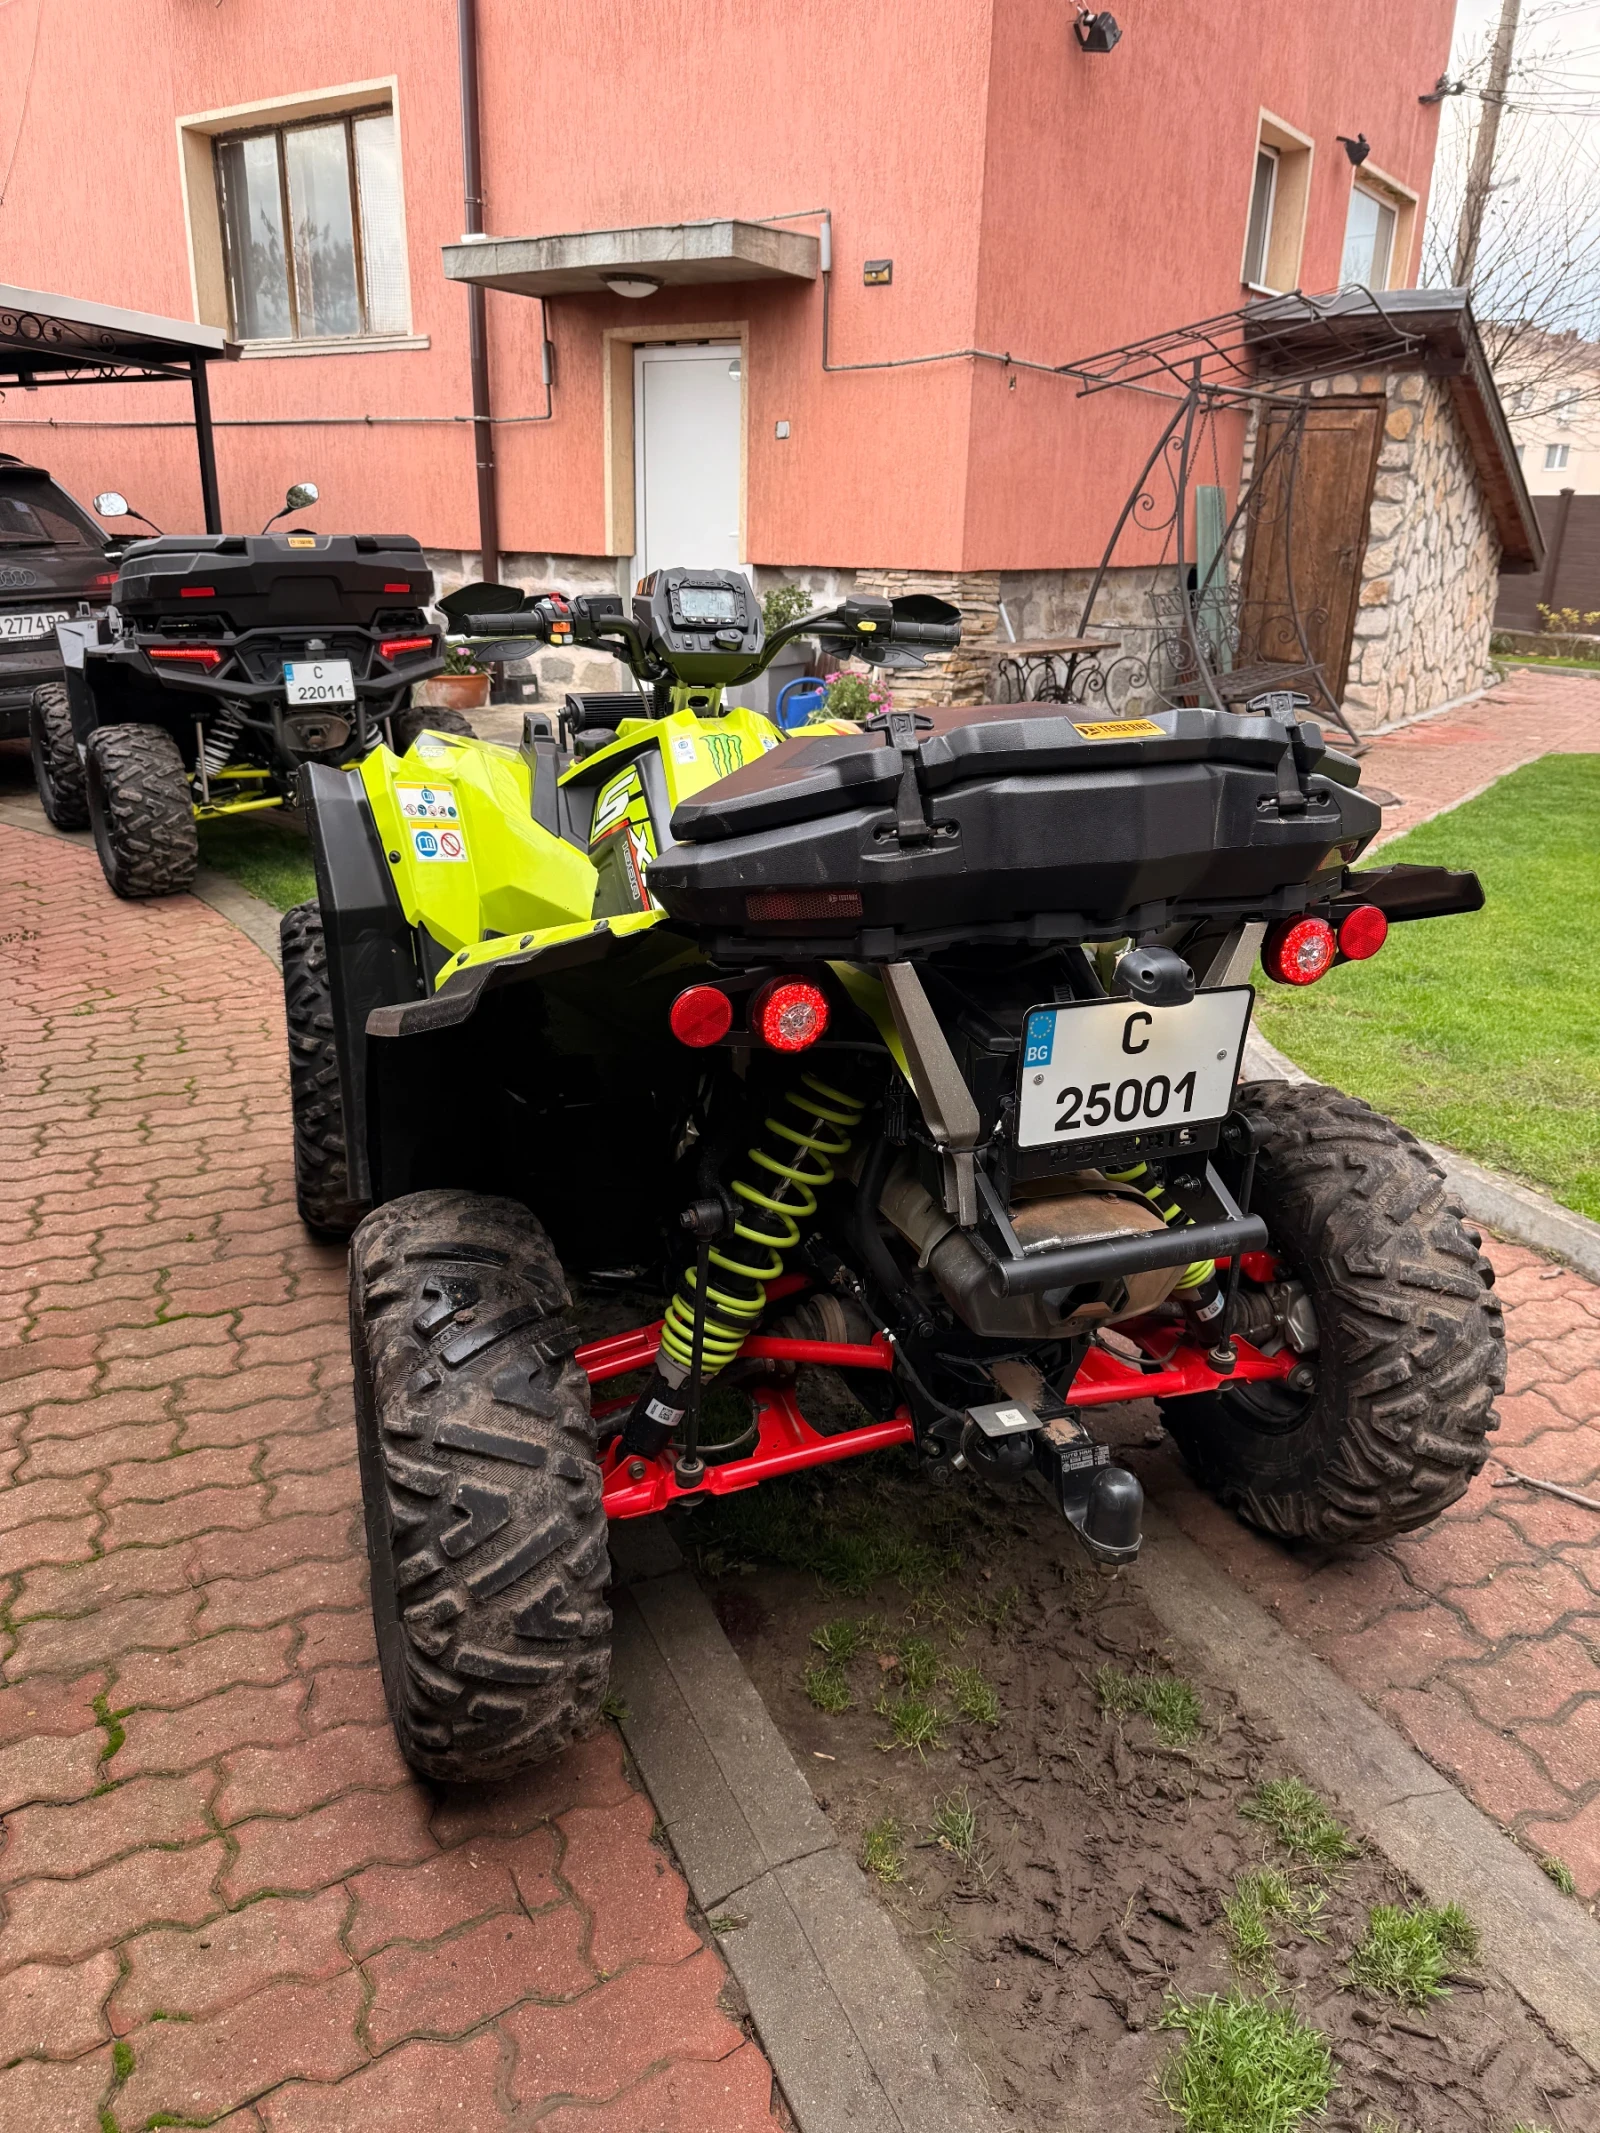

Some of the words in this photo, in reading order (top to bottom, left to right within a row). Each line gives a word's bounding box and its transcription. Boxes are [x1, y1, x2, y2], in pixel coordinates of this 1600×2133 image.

[313, 666, 323, 679] C
[298, 685, 344, 700] 22011
[1097, 722, 1157, 733] TESSERACT
[621, 840, 640, 901] 1000
[1122, 1011, 1153, 1055] C
[1027, 1045, 1048, 1061] BG
[1054, 1071, 1197, 1132] 25001
[1050, 1128, 1198, 1167] POLARIS
